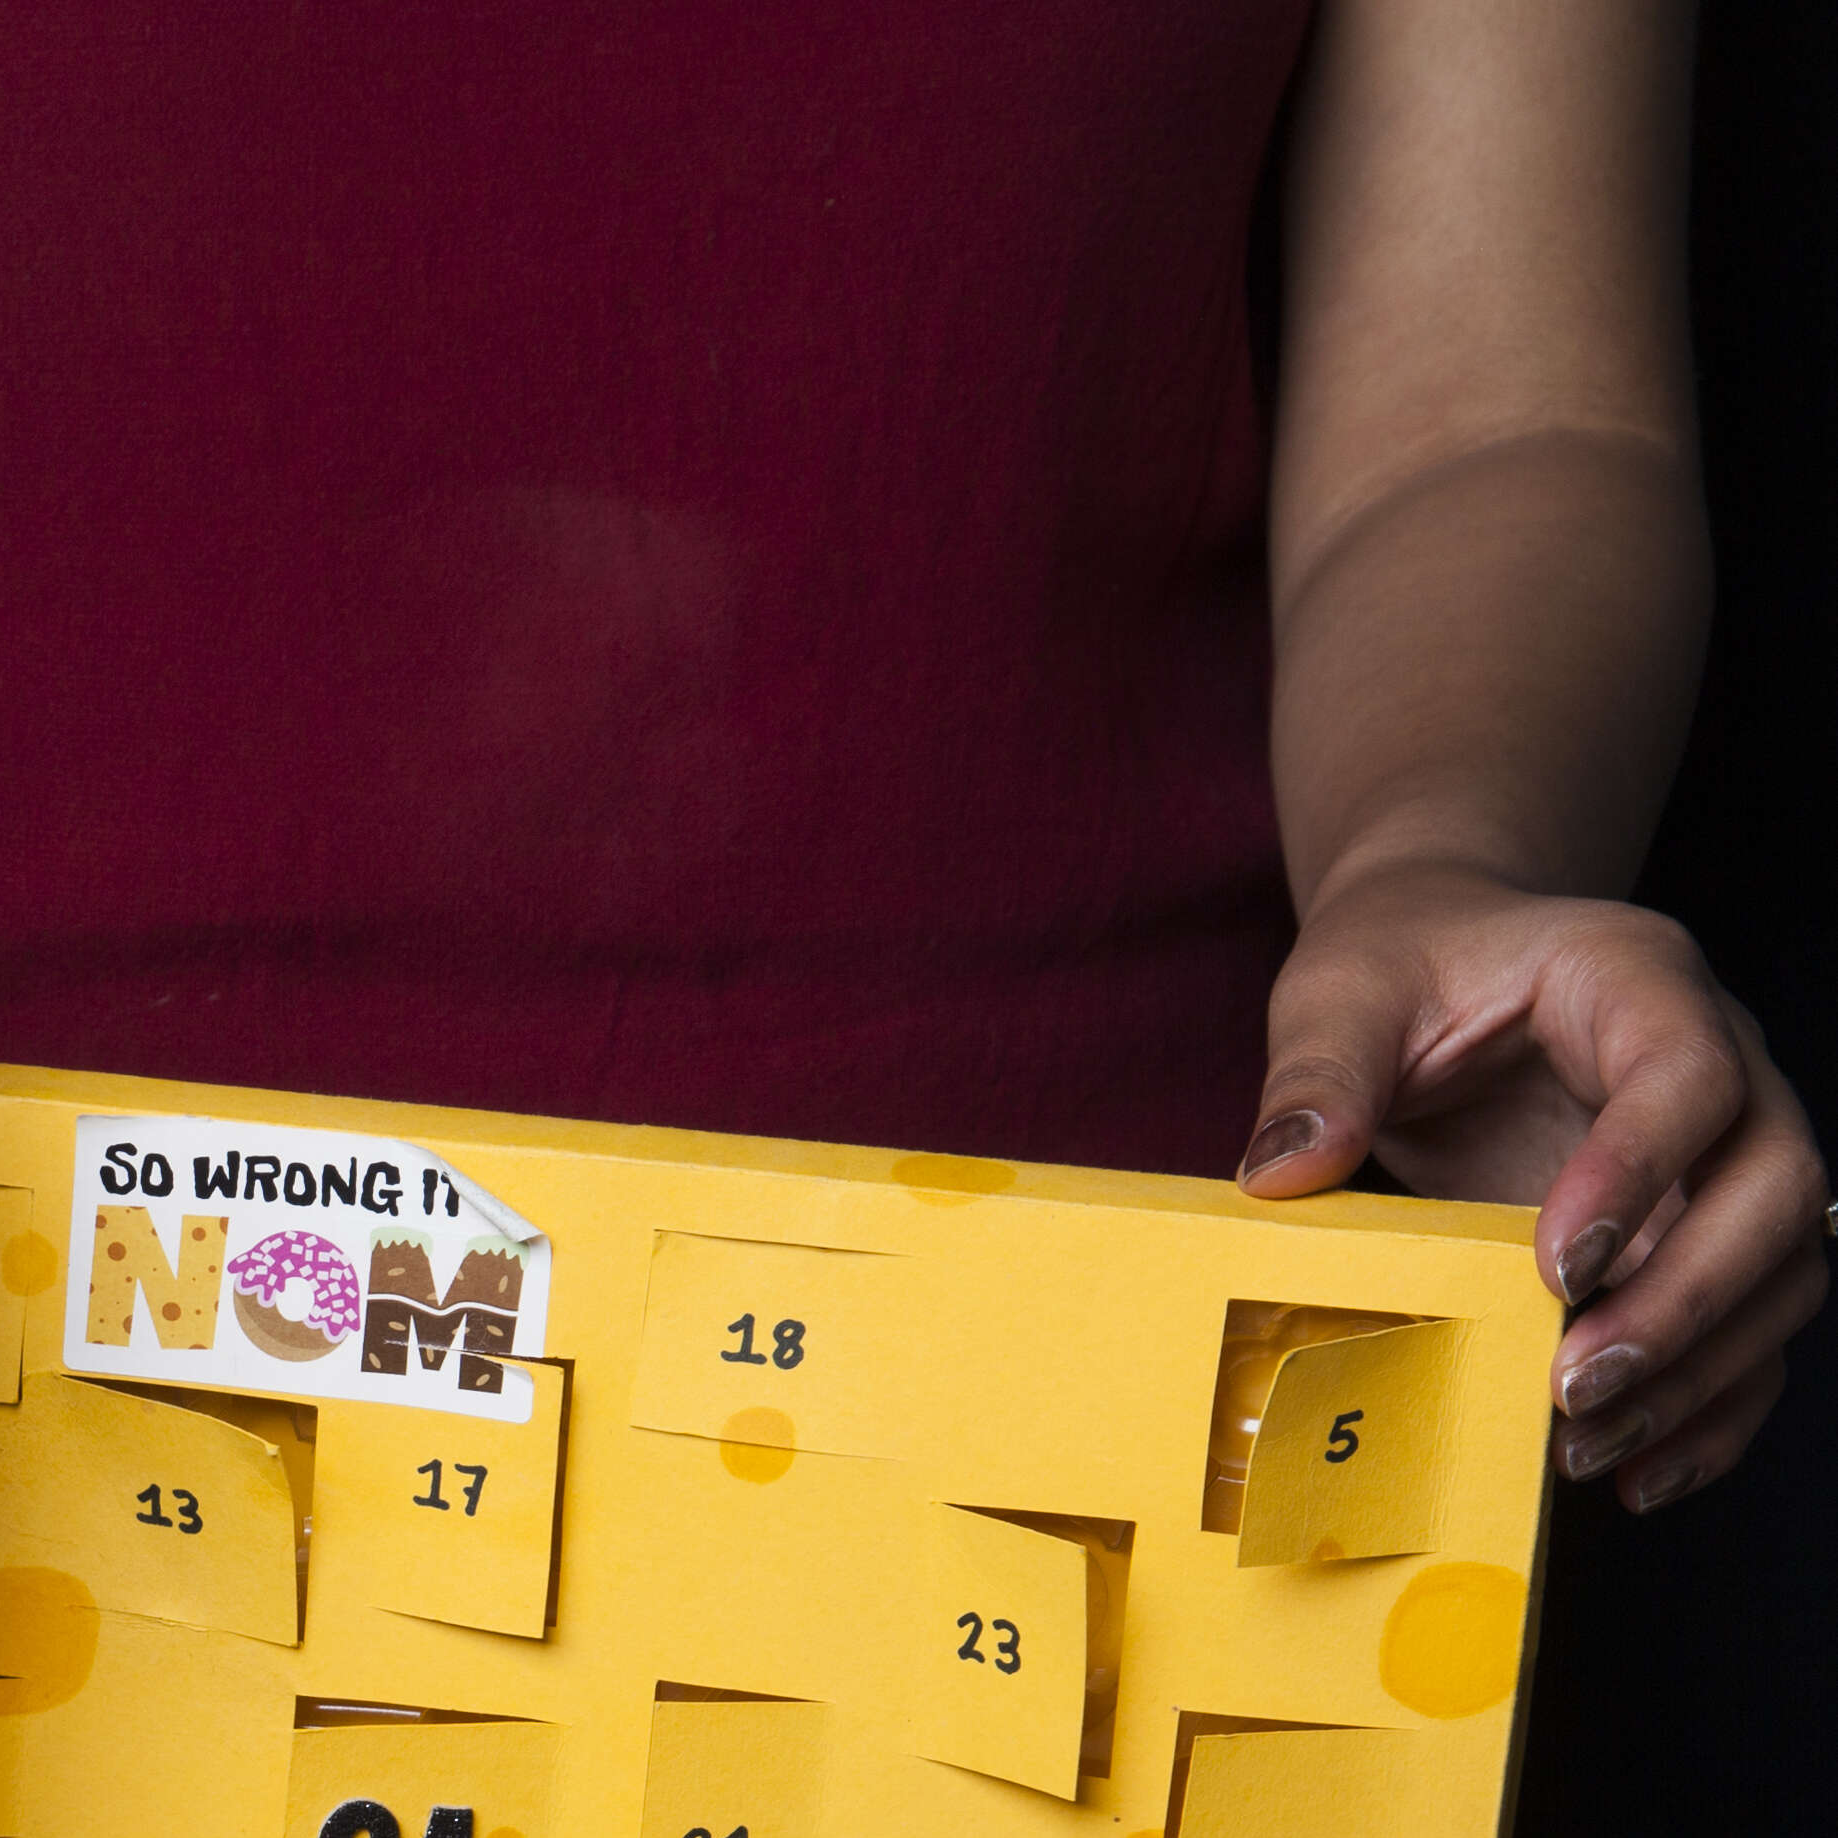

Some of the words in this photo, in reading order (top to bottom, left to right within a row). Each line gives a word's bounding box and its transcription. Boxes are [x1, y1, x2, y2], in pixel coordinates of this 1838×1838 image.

[99, 1141, 174, 1198] SO
[193, 1150, 404, 1217] WRONG
[85, 1203, 530, 1394] NOM
[721, 1312, 806, 1371] 18
[1324, 1408, 1365, 1465] 5
[135, 1483, 204, 1535] 13
[413, 1458, 489, 1517] 17
[957, 1612, 1022, 1676] 23
